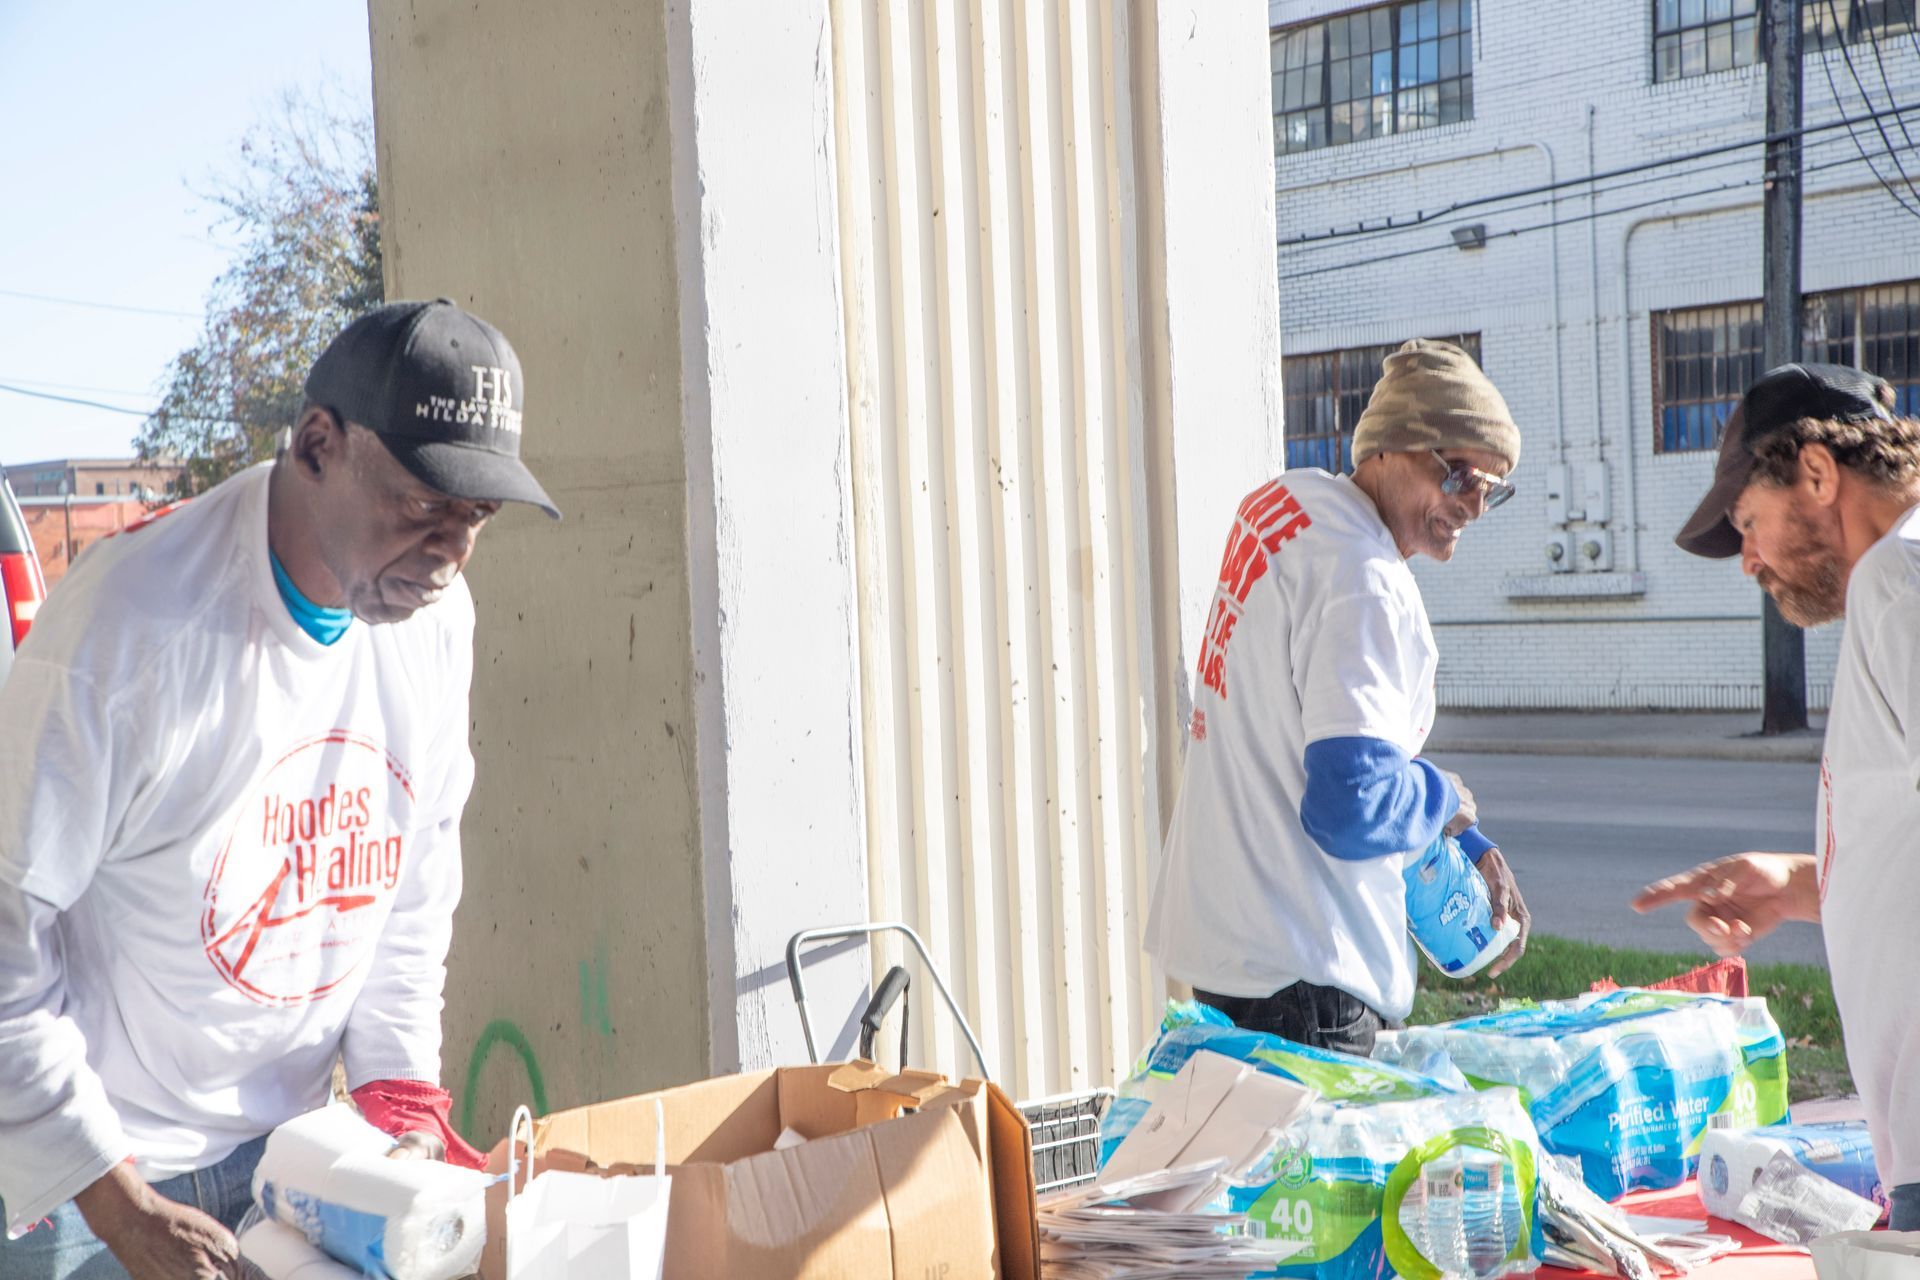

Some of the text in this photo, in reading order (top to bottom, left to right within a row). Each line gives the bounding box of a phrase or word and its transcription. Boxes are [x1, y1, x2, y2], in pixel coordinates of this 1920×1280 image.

[416, 403, 485, 427] HILDA
[295, 832, 402, 903] Haling
[1607, 1102, 1666, 1132] Purified
[1670, 1096, 1710, 1120] Water
[1270, 1198, 1313, 1234] 40
